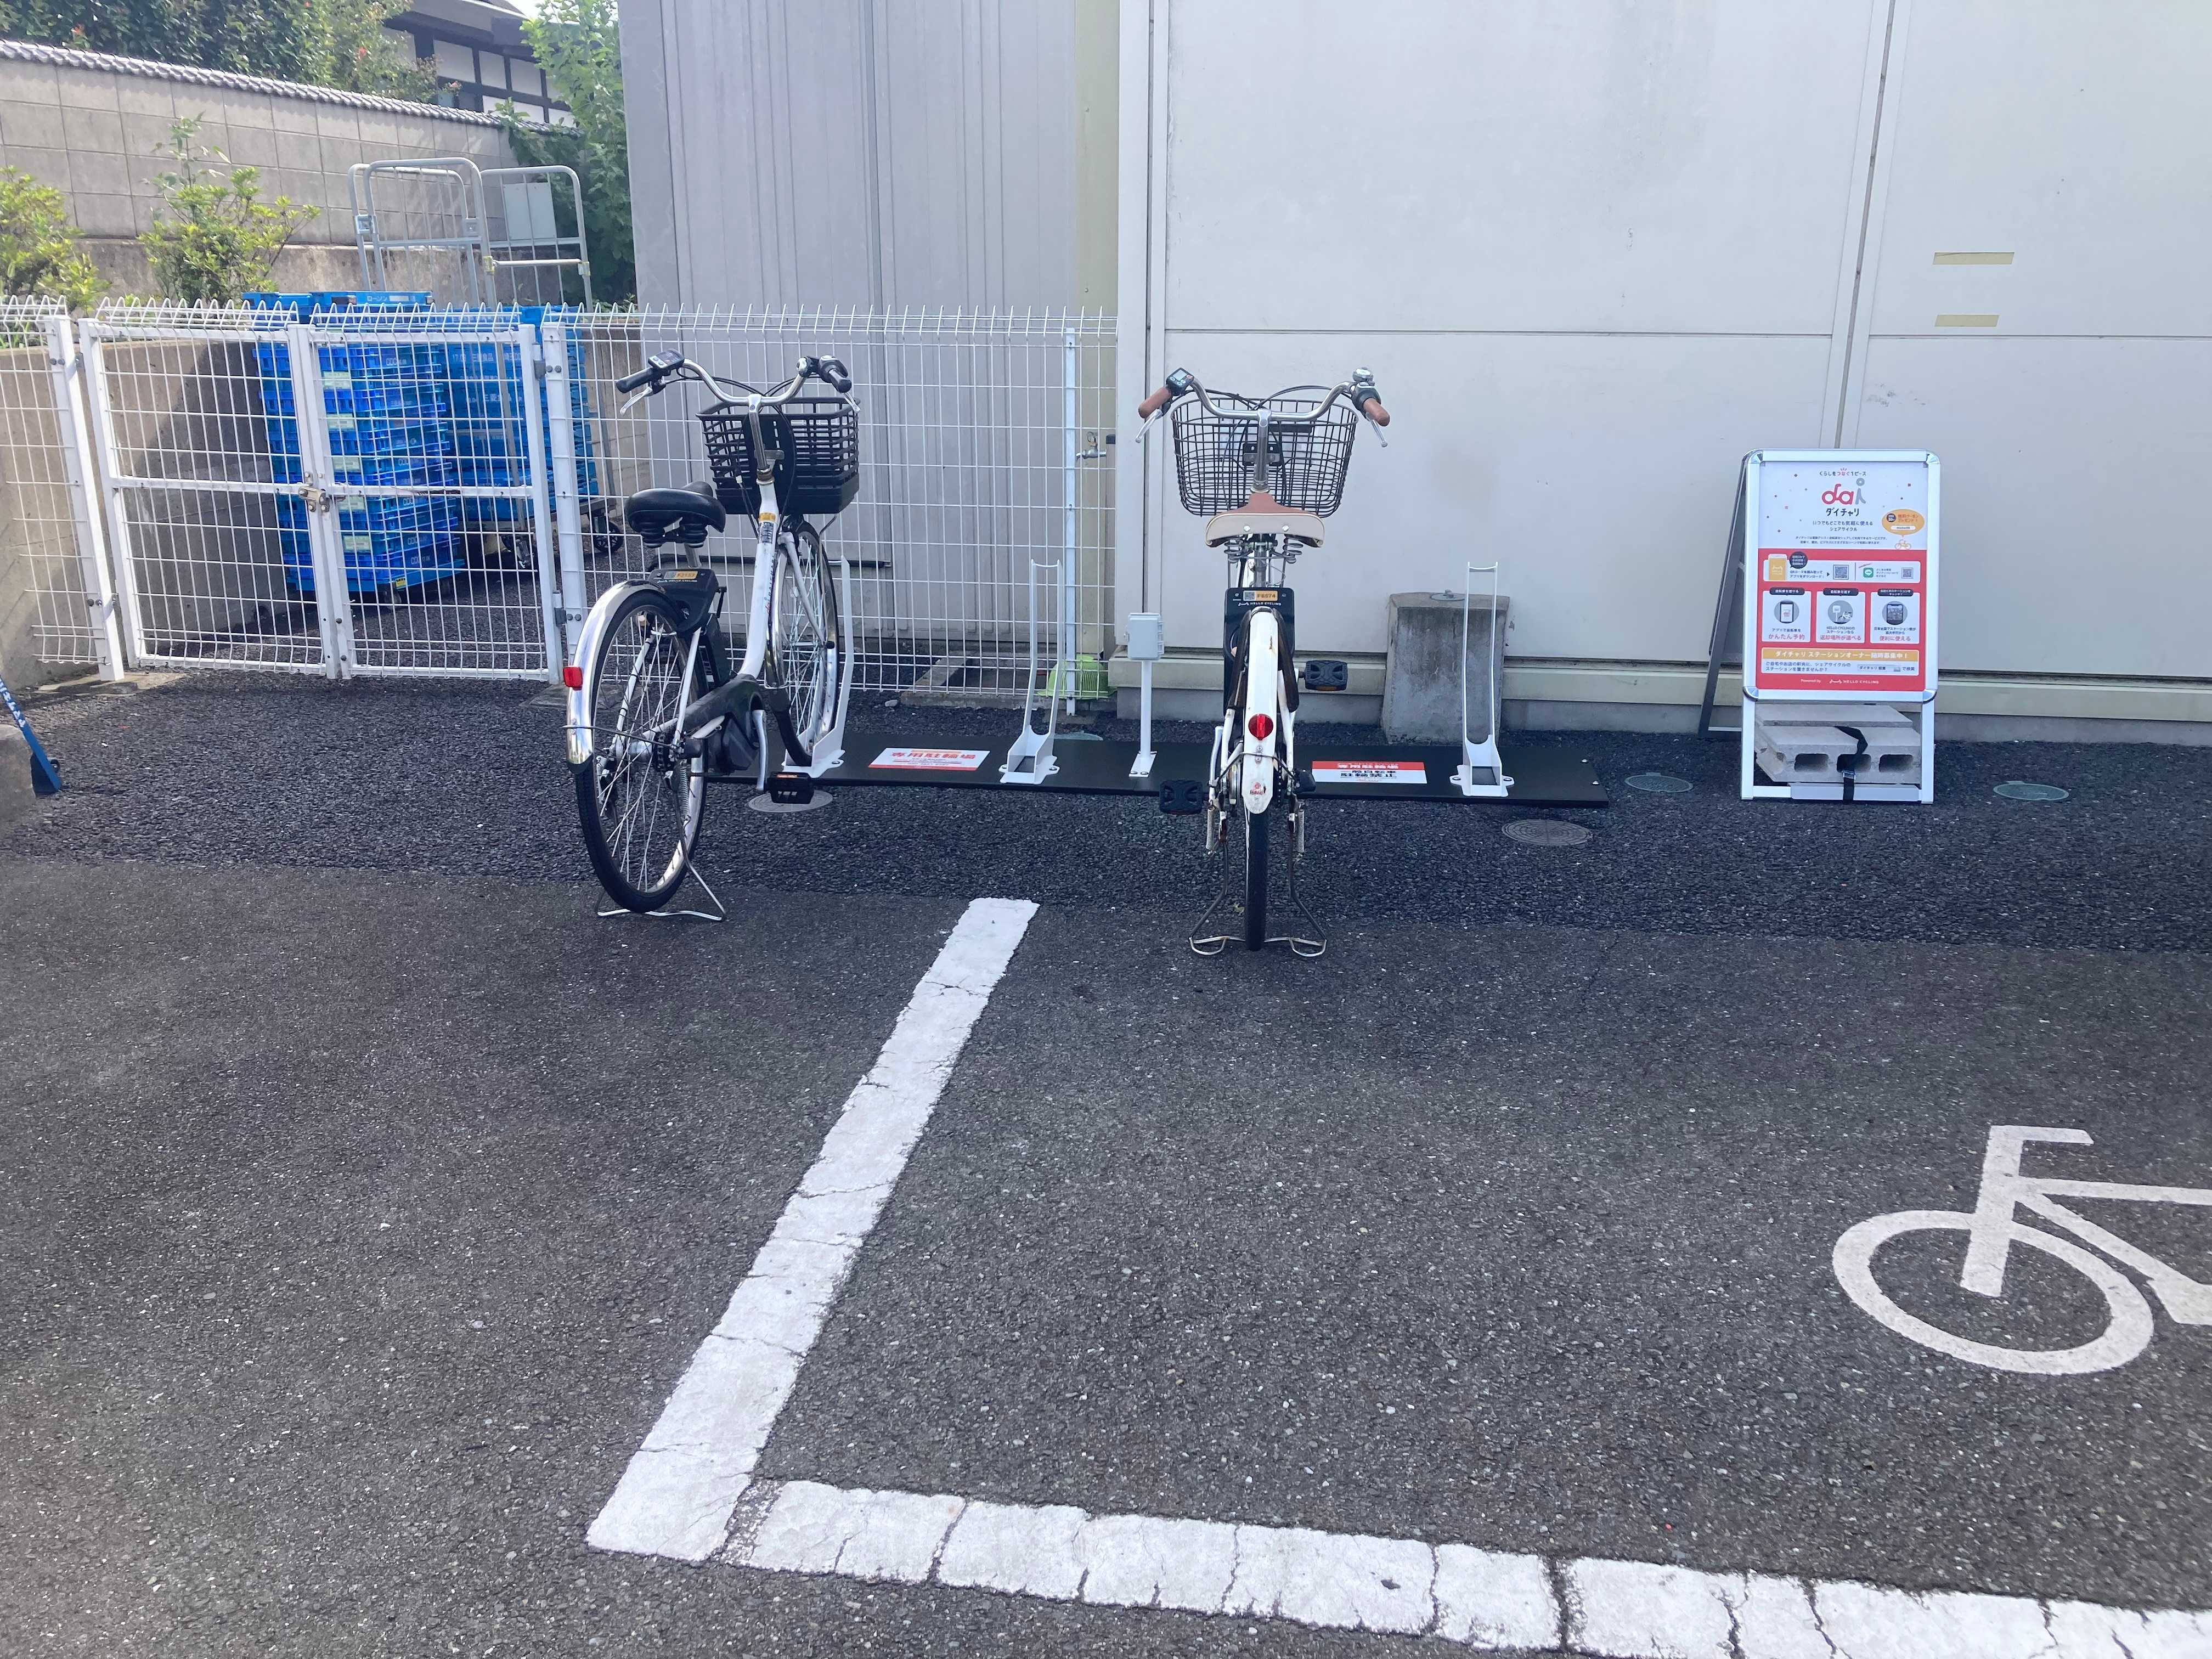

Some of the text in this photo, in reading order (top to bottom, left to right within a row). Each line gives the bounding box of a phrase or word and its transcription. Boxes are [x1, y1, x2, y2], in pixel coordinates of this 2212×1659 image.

[1822, 478, 1866, 505] dai
[1826, 507, 1859, 516] ダイチャリ
